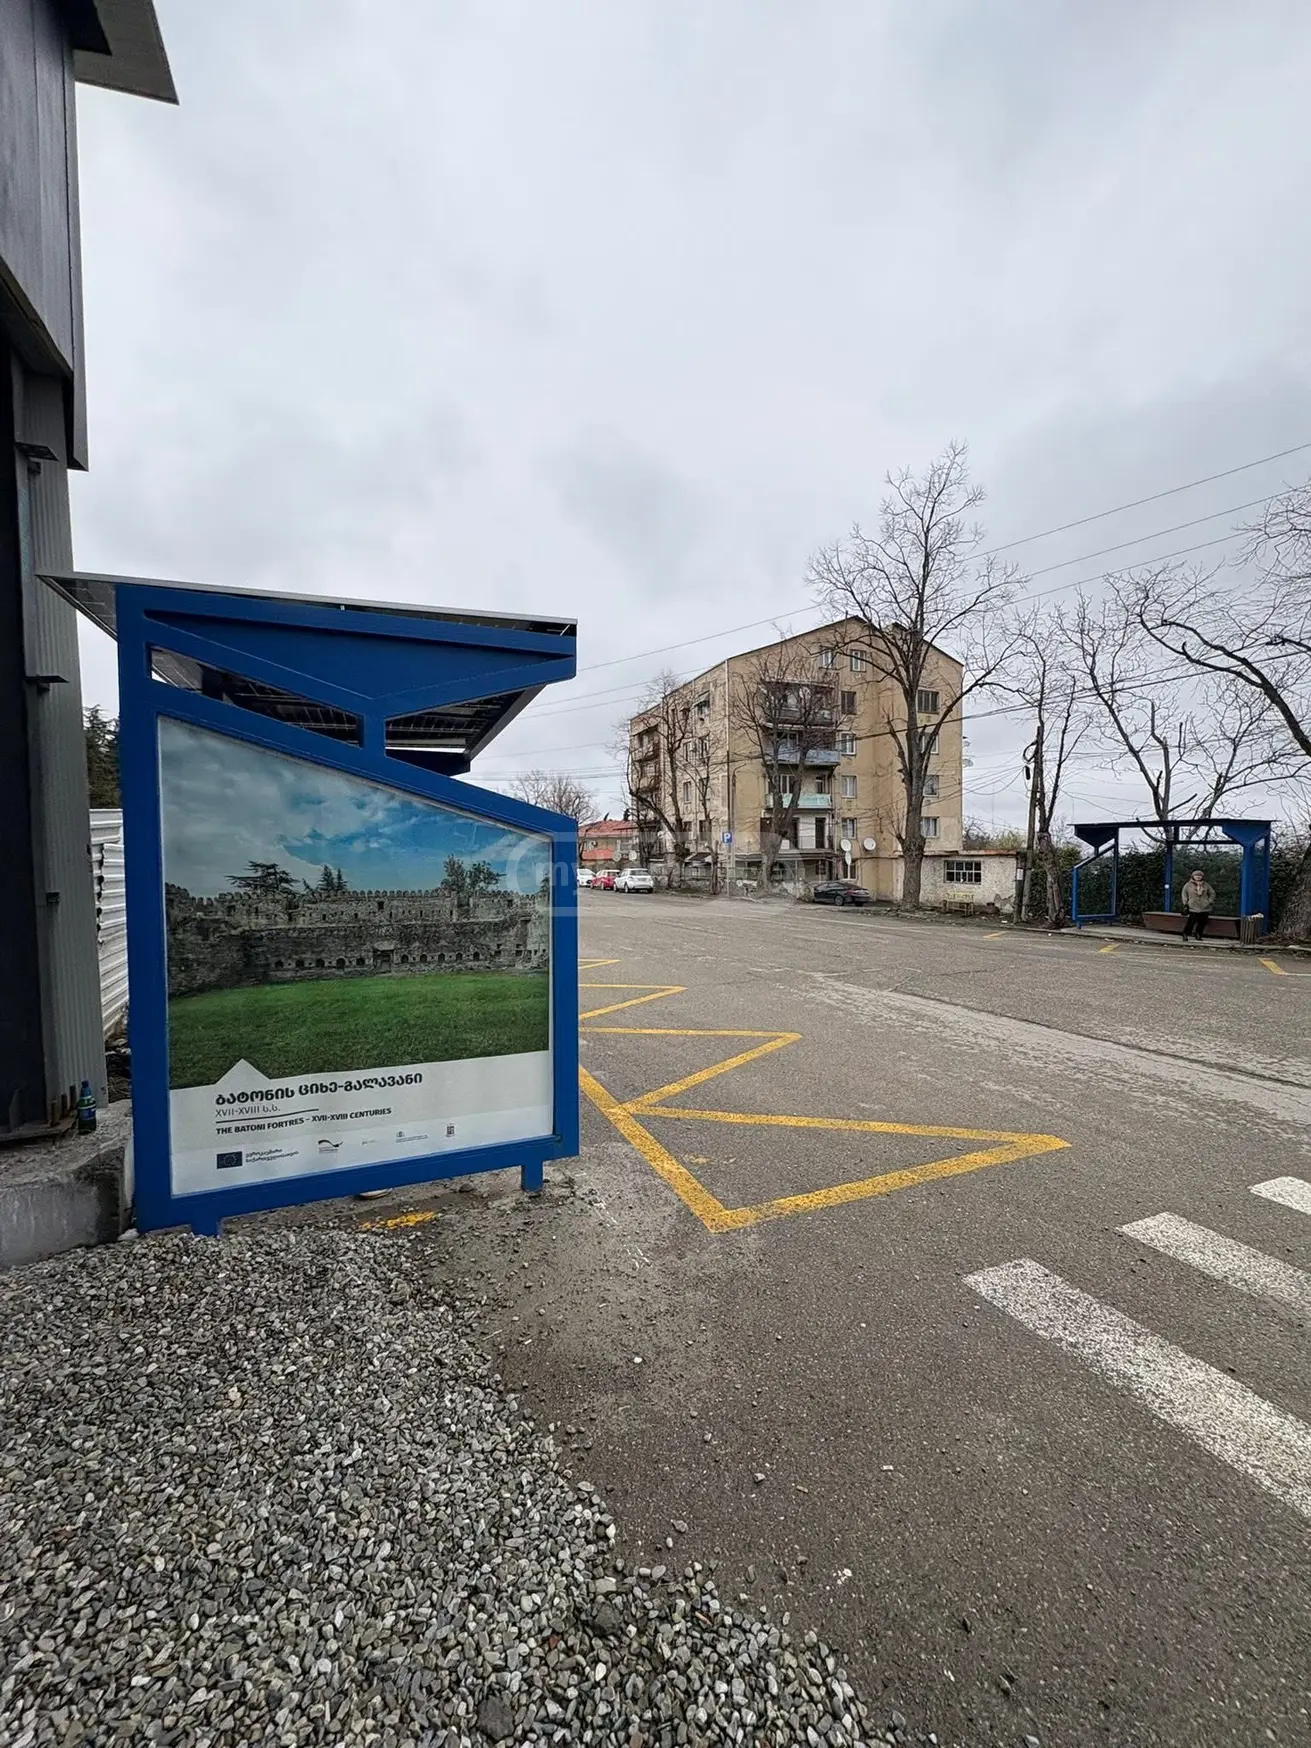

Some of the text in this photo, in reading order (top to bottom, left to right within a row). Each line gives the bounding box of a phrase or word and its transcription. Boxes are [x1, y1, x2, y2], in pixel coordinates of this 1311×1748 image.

[215, 1072, 423, 1106] ბატონის ციხე-გალავანი
[215, 1105, 260, 1118] XVII-XVIII
[216, 1126, 233, 1135] THE
[234, 1123, 266, 1133] BATONI
[267, 1117, 305, 1130] FORTRES
[349, 1107, 392, 1119] CENTURIES
